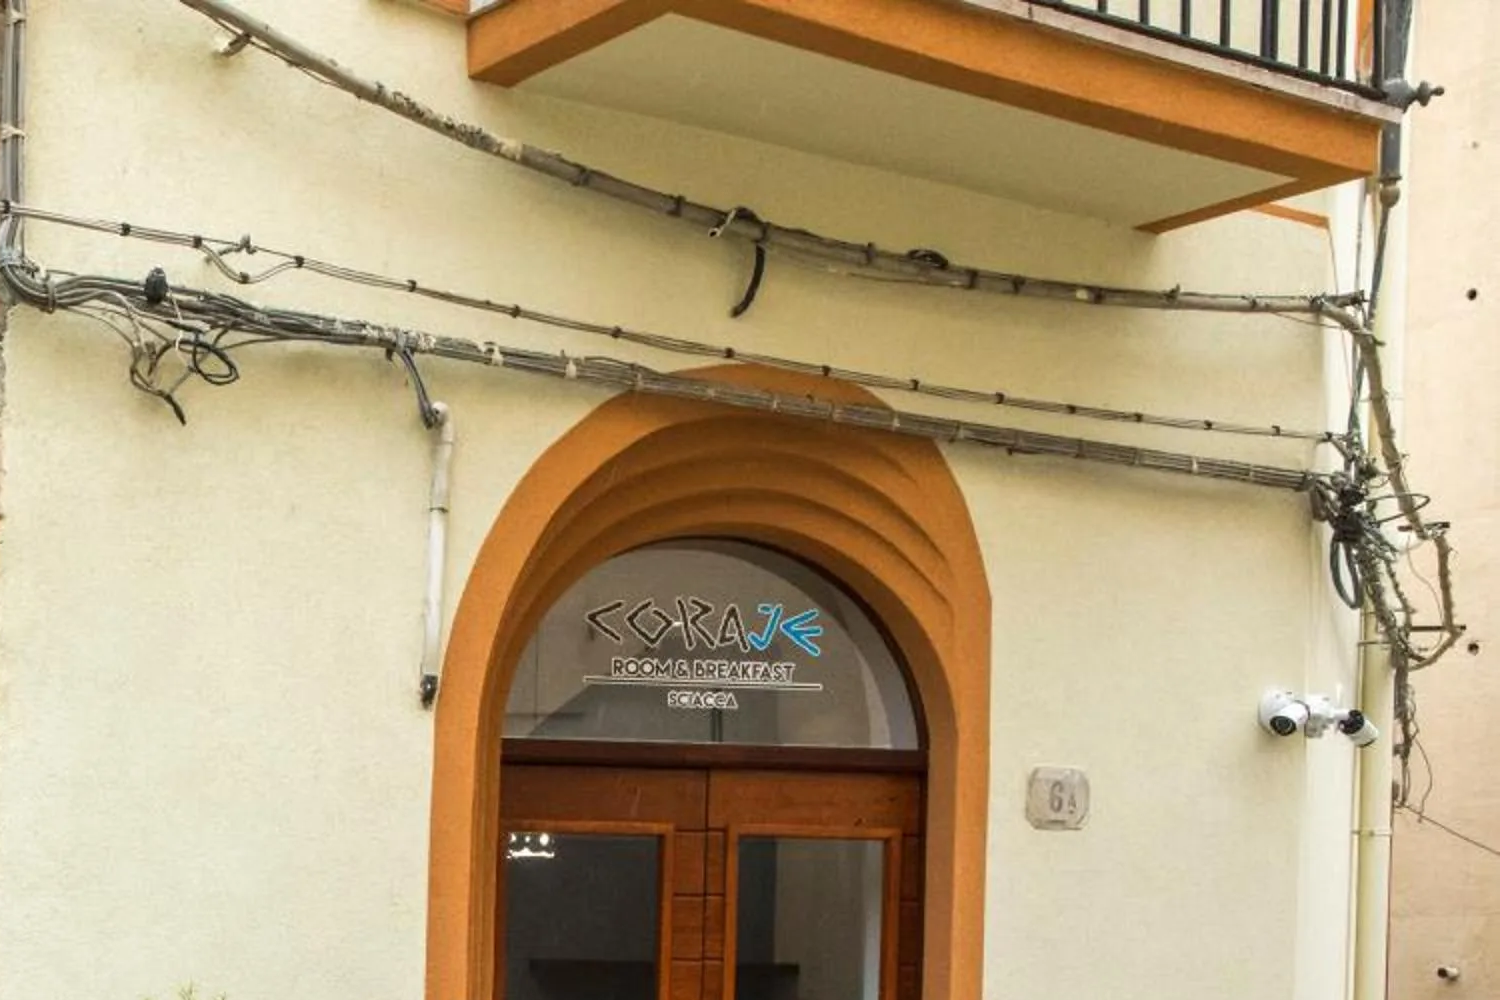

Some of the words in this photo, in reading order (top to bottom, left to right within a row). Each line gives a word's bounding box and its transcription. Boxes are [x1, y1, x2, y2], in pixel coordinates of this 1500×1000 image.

[587, 598, 824, 656] CORAJE
[611, 657, 672, 678] ROOM
[674, 660, 690, 678] &
[693, 661, 797, 683] BREAKFAST
[667, 690, 739, 709] SCIACCA
